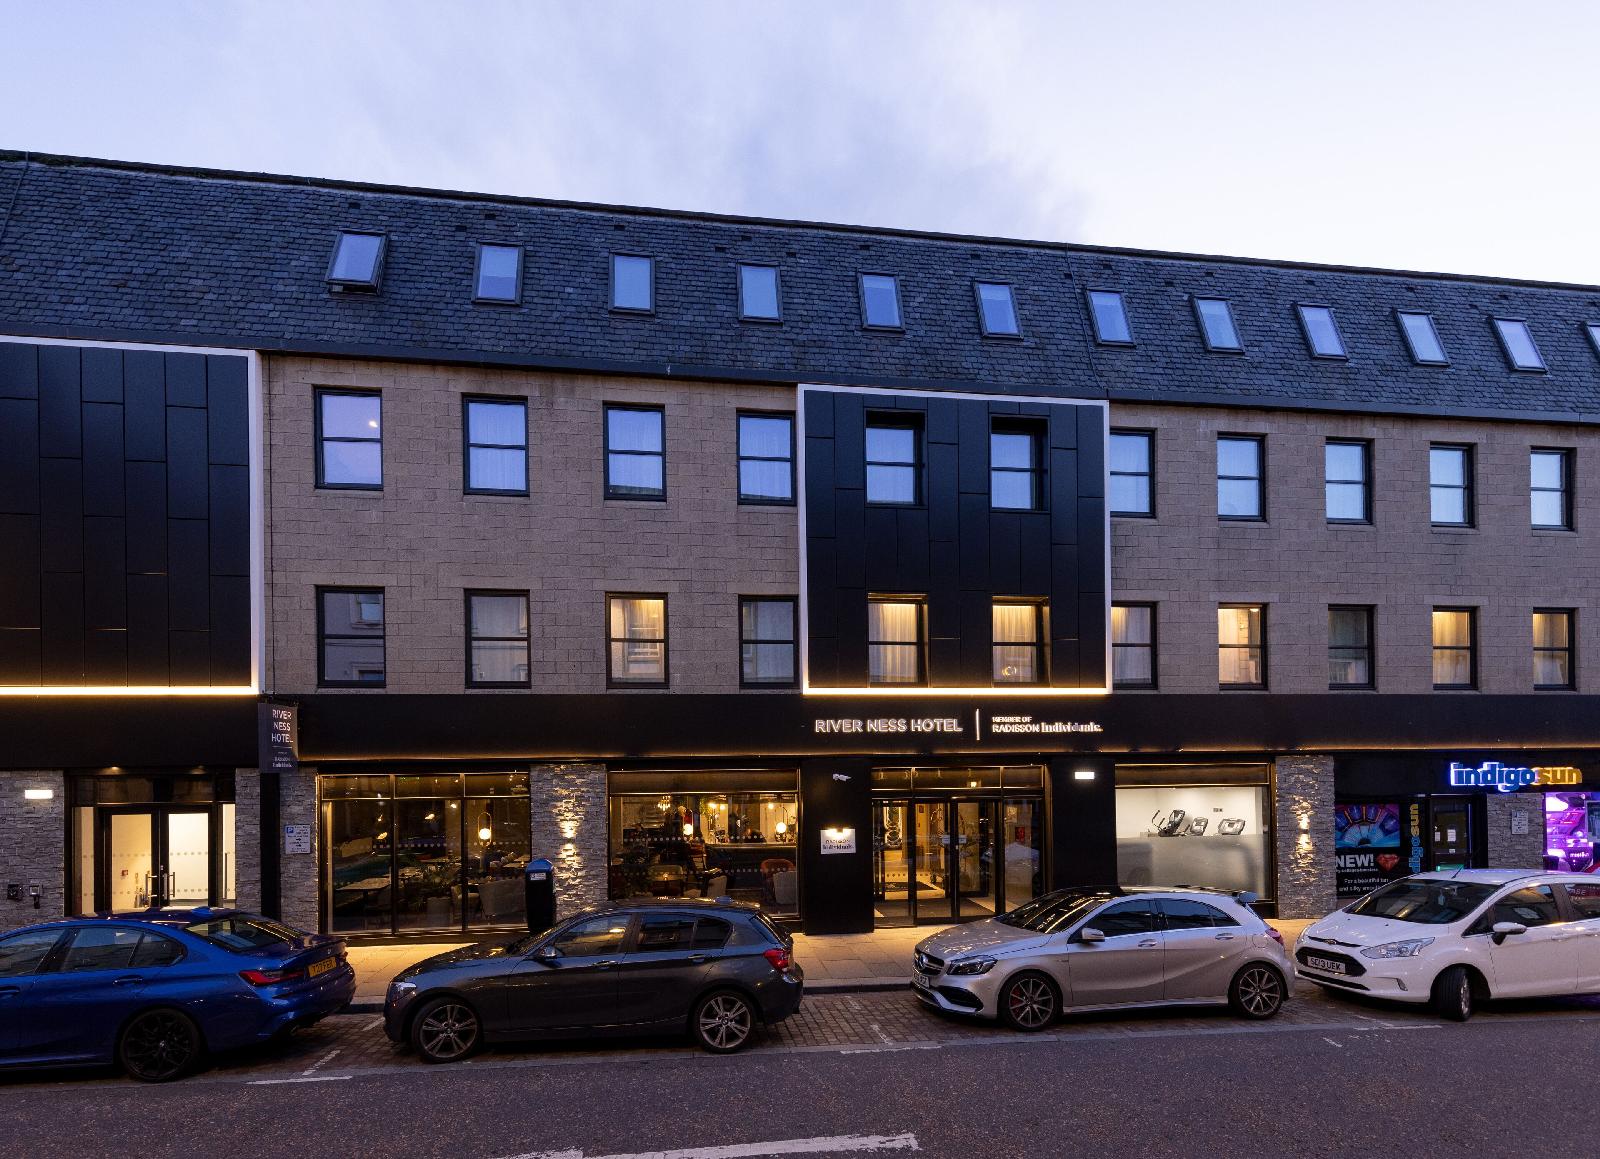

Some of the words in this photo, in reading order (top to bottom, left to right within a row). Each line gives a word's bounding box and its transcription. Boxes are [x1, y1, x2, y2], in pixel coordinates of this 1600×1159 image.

[272, 709, 292, 720] RIVER
[273, 721, 291, 731] NESS
[815, 719, 863, 733] RIVER
[867, 719, 907, 732] NESS
[911, 719, 963, 732] HOTEL
[992, 723, 1040, 733] RADISSON
[271, 732, 294, 743] HOTEL
[1450, 761, 1583, 792] indigosun
[1408, 803, 1424, 874] digosun
[1335, 854, 1375, 868] NEW!
